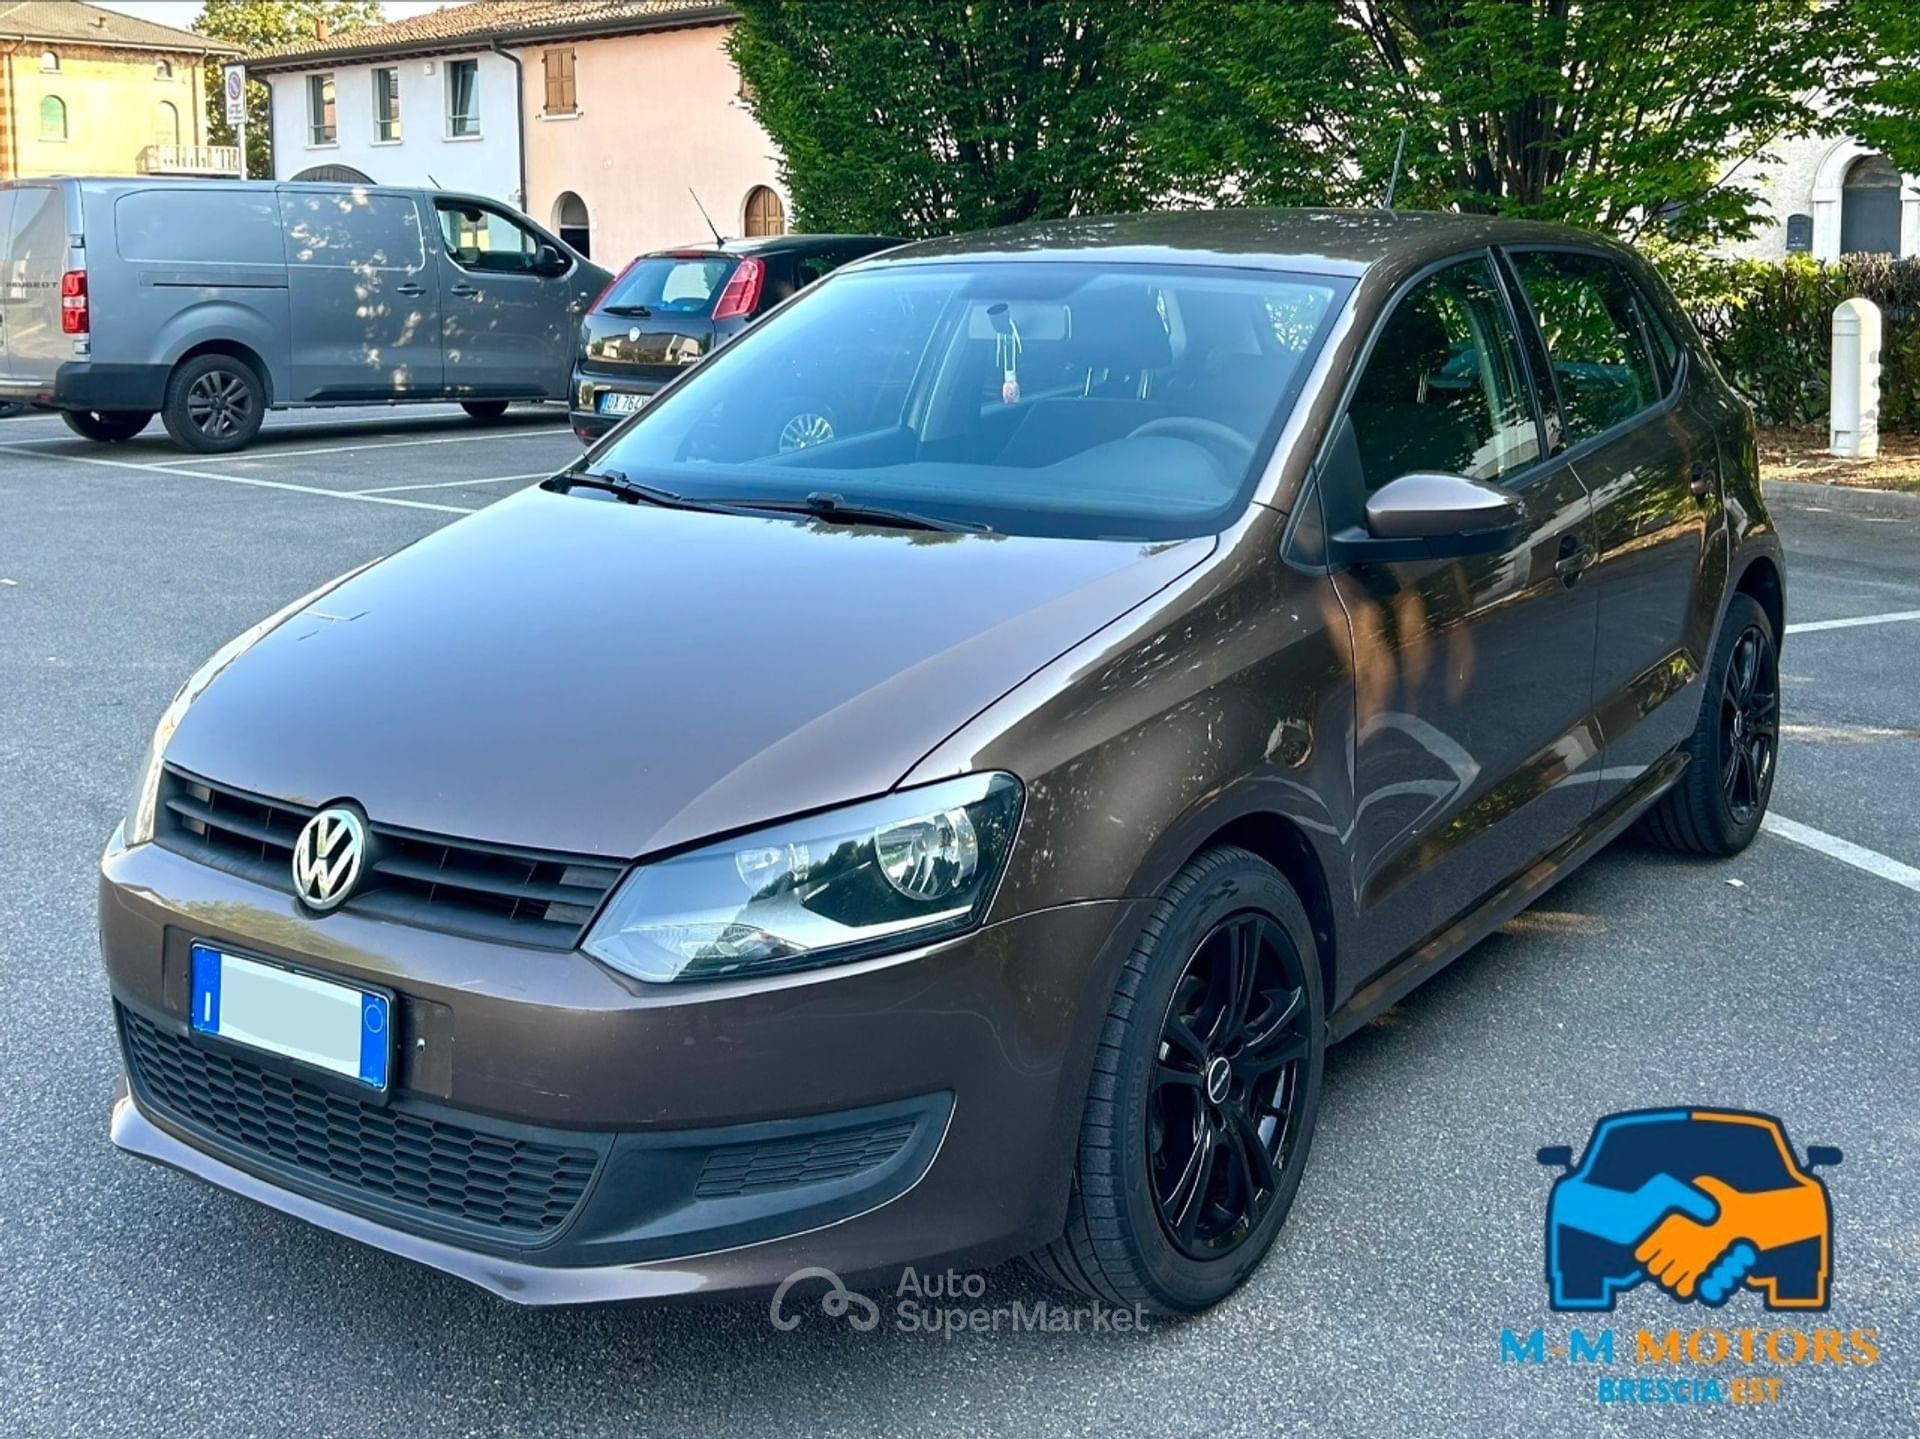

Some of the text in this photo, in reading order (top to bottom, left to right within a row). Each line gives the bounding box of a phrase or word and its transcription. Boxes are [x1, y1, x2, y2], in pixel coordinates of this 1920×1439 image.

[6, 281, 58, 289] PEUGEOT
[293, 808, 365, 911] VW
[1127, 1055, 1144, 1163] KUMHO
